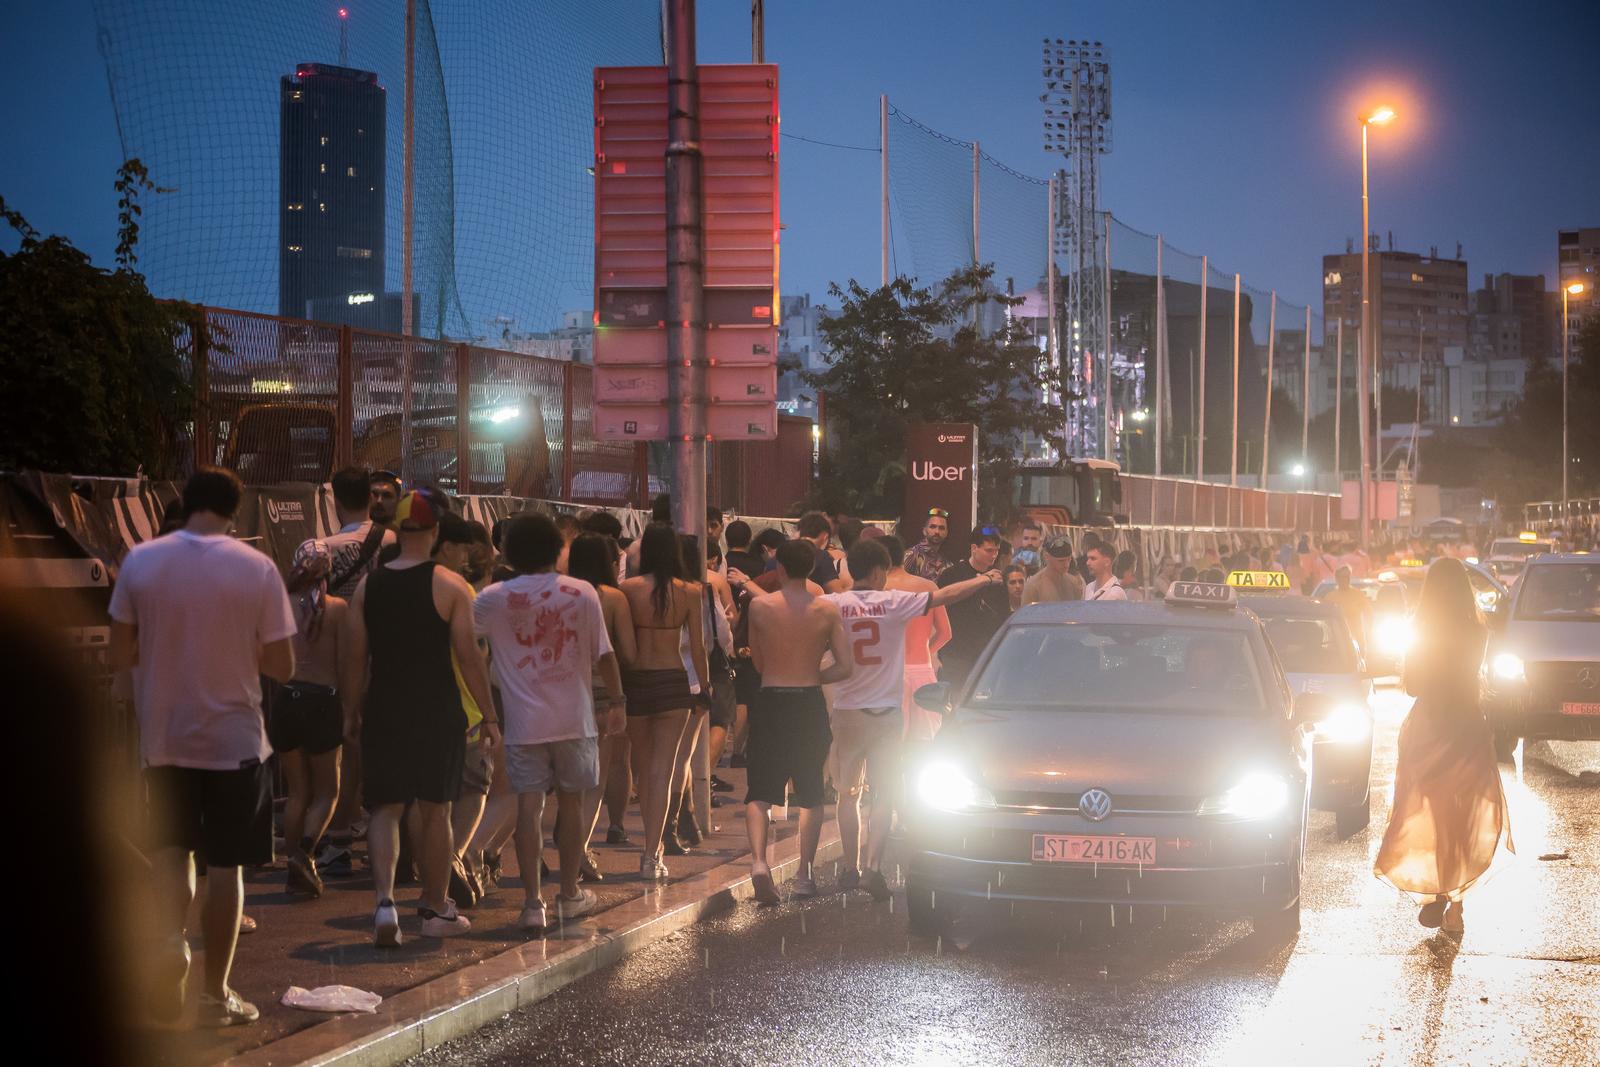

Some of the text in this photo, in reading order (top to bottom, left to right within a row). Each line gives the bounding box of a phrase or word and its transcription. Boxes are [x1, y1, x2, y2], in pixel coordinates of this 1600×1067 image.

[912, 461, 967, 480] Uber
[1233, 573, 1285, 586] TAXI
[1181, 584, 1225, 597] TAXI
[841, 603, 887, 617] HAKIMI
[851, 620, 882, 666] 2
[1047, 838, 1069, 858] ST
